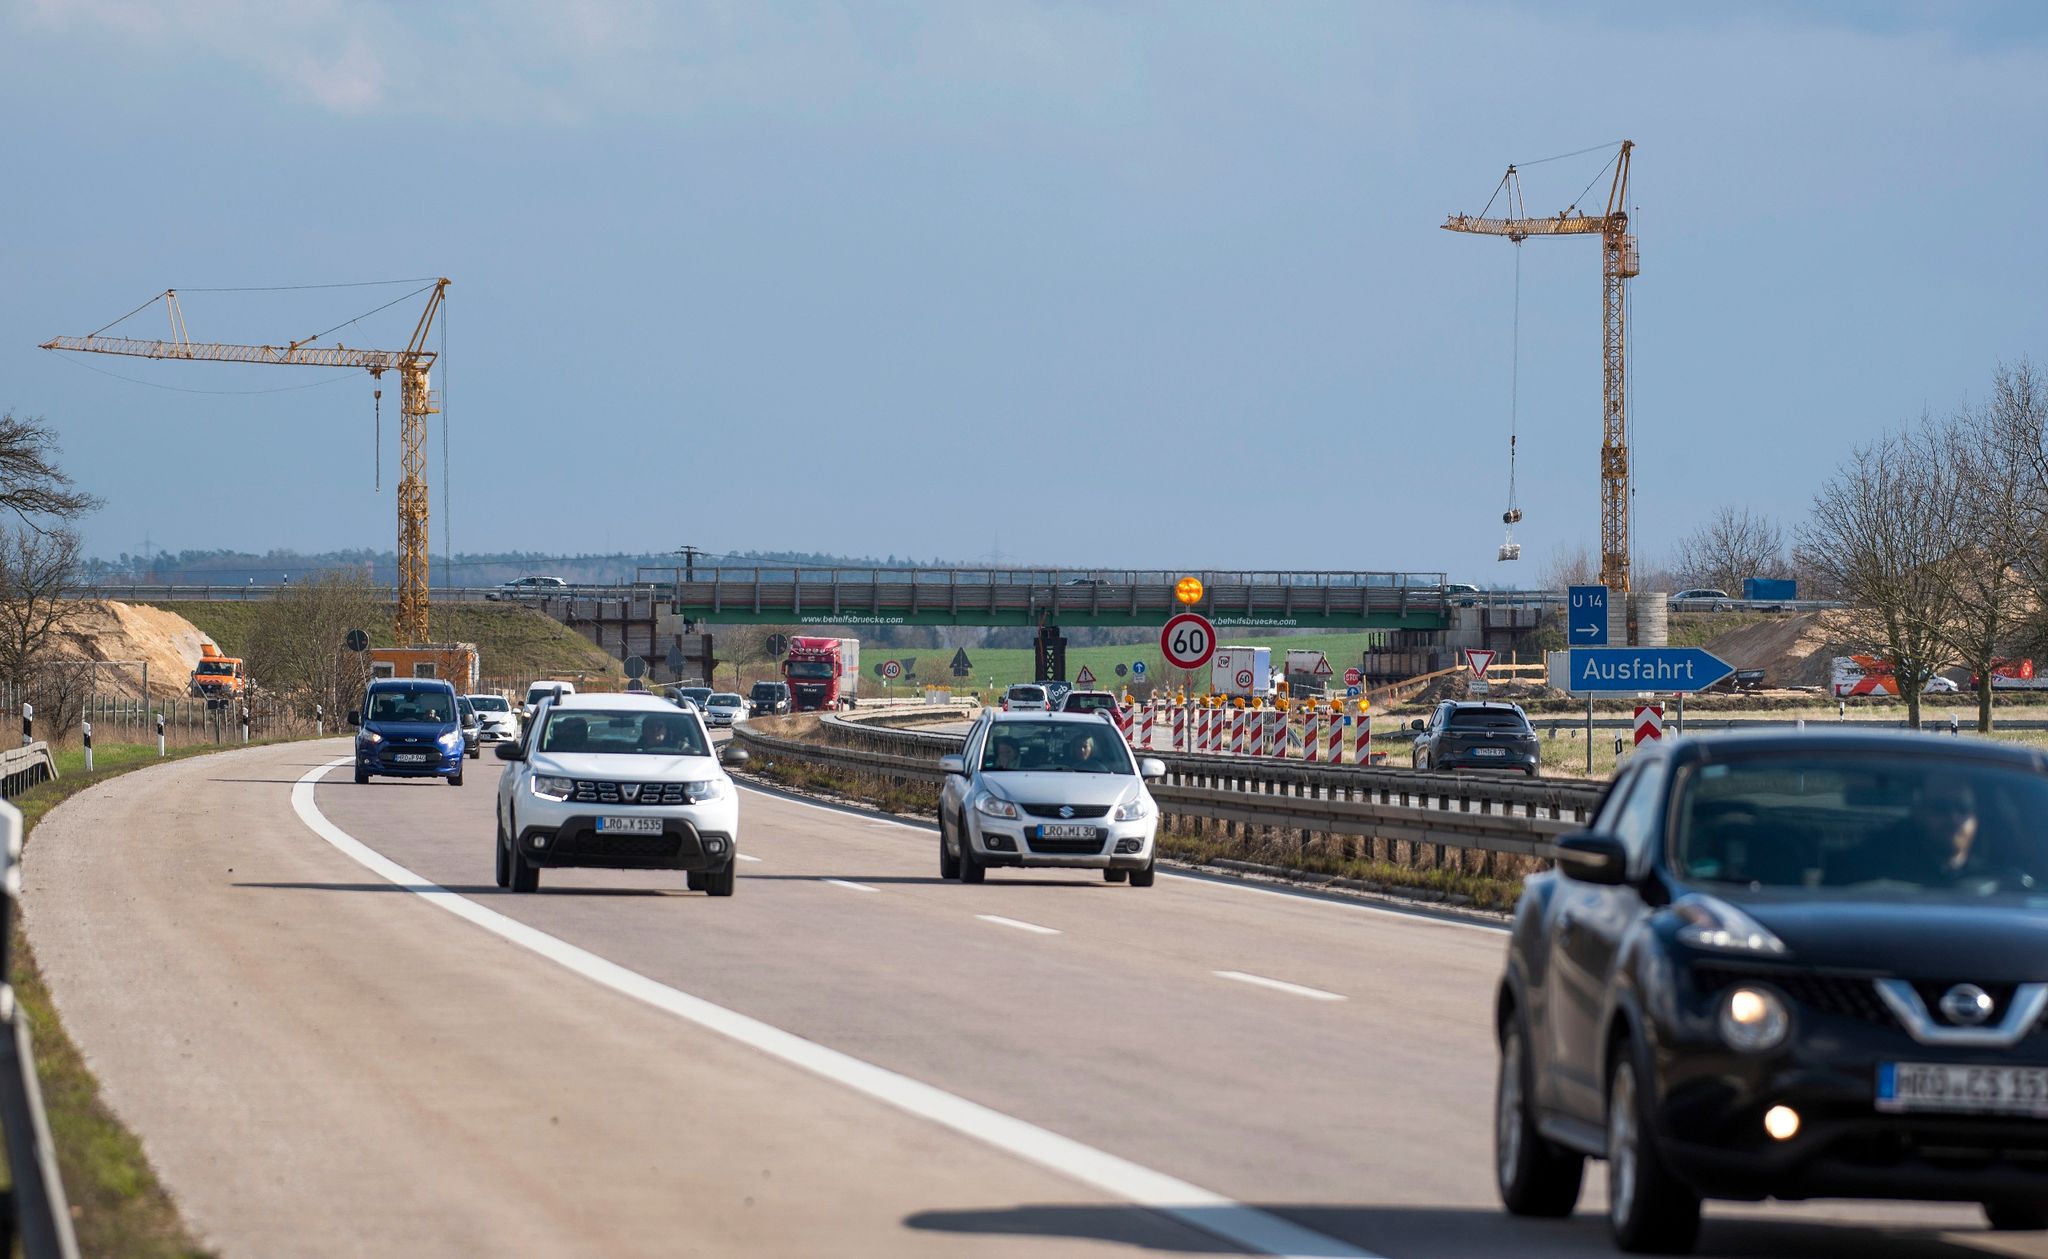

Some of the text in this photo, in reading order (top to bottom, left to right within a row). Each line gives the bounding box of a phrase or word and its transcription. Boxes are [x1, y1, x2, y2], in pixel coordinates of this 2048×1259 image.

[1572, 594, 1603, 608] U 14
[801, 615, 904, 624] www.behelfsbruecke.com
[1208, 617, 1297, 626] w.behelfsbruecke.com
[1173, 629, 1204, 655] 60
[886, 665, 897, 675] 60
[1582, 657, 1694, 680] Ausfahrt
[1239, 674, 1250, 684] 60
[1345, 673, 1360, 681] STOP
[1051, 684, 1069, 697] bsb
[604, 819, 623, 830] LRO
[639, 819, 661, 831] 1535
[1043, 826, 1063, 836] LRO
[1083, 826, 1096, 837] 30
